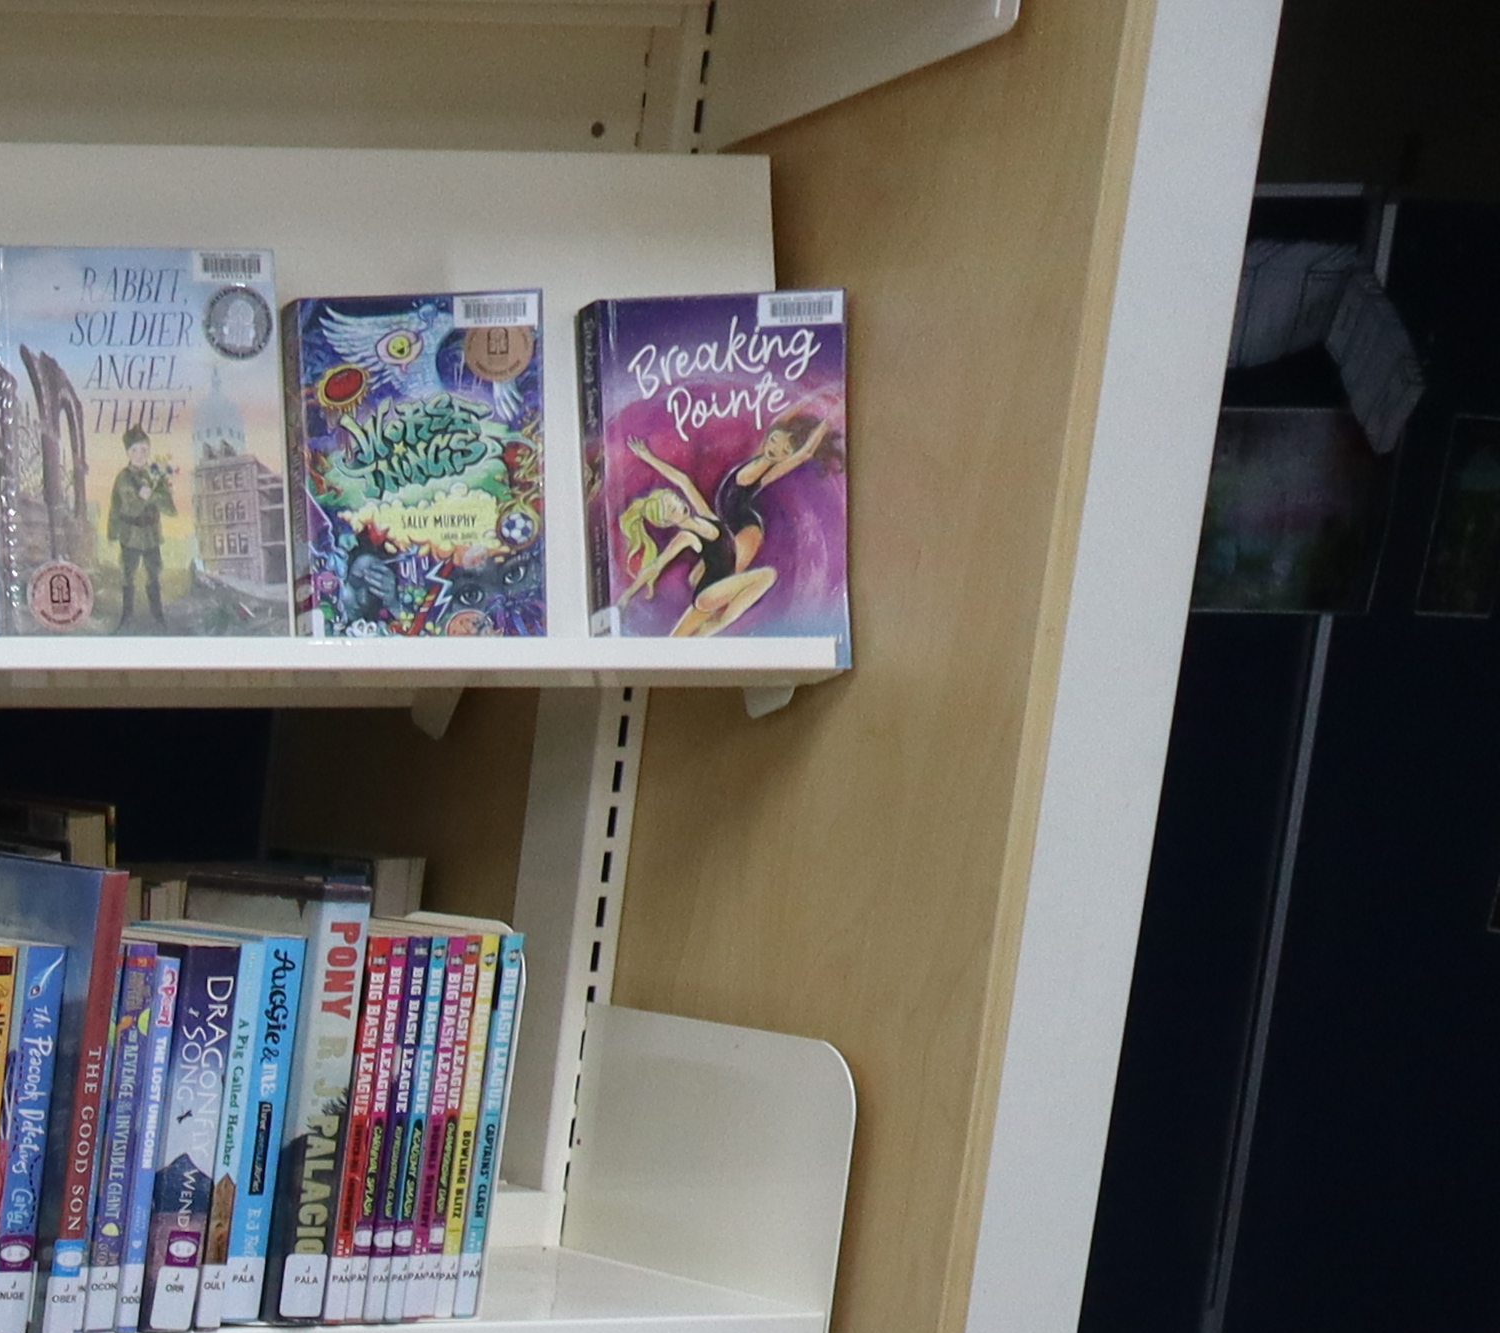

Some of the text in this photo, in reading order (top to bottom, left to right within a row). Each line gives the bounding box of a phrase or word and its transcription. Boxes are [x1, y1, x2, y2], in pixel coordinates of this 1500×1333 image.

[82, 267, 189, 306] RABBIT,
[83, 355, 193, 392] ANGEL,
[629, 324, 822, 397] Breaking
[89, 400, 187, 435] THIEF
[339, 394, 494, 465] WORSE
[665, 374, 791, 442] Pointe
[341, 432, 503, 499] THINGS
[401, 514, 477, 529] SALLY MURPHY
[321, 921, 361, 1020] PONY
[179, 1022, 206, 1100] SONG
[197, 976, 234, 1154] DRAGONFLY
[141, 1037, 168, 1169] THE LOST UNICORN
[67, 1047, 102, 1233] THE GOOD SON
